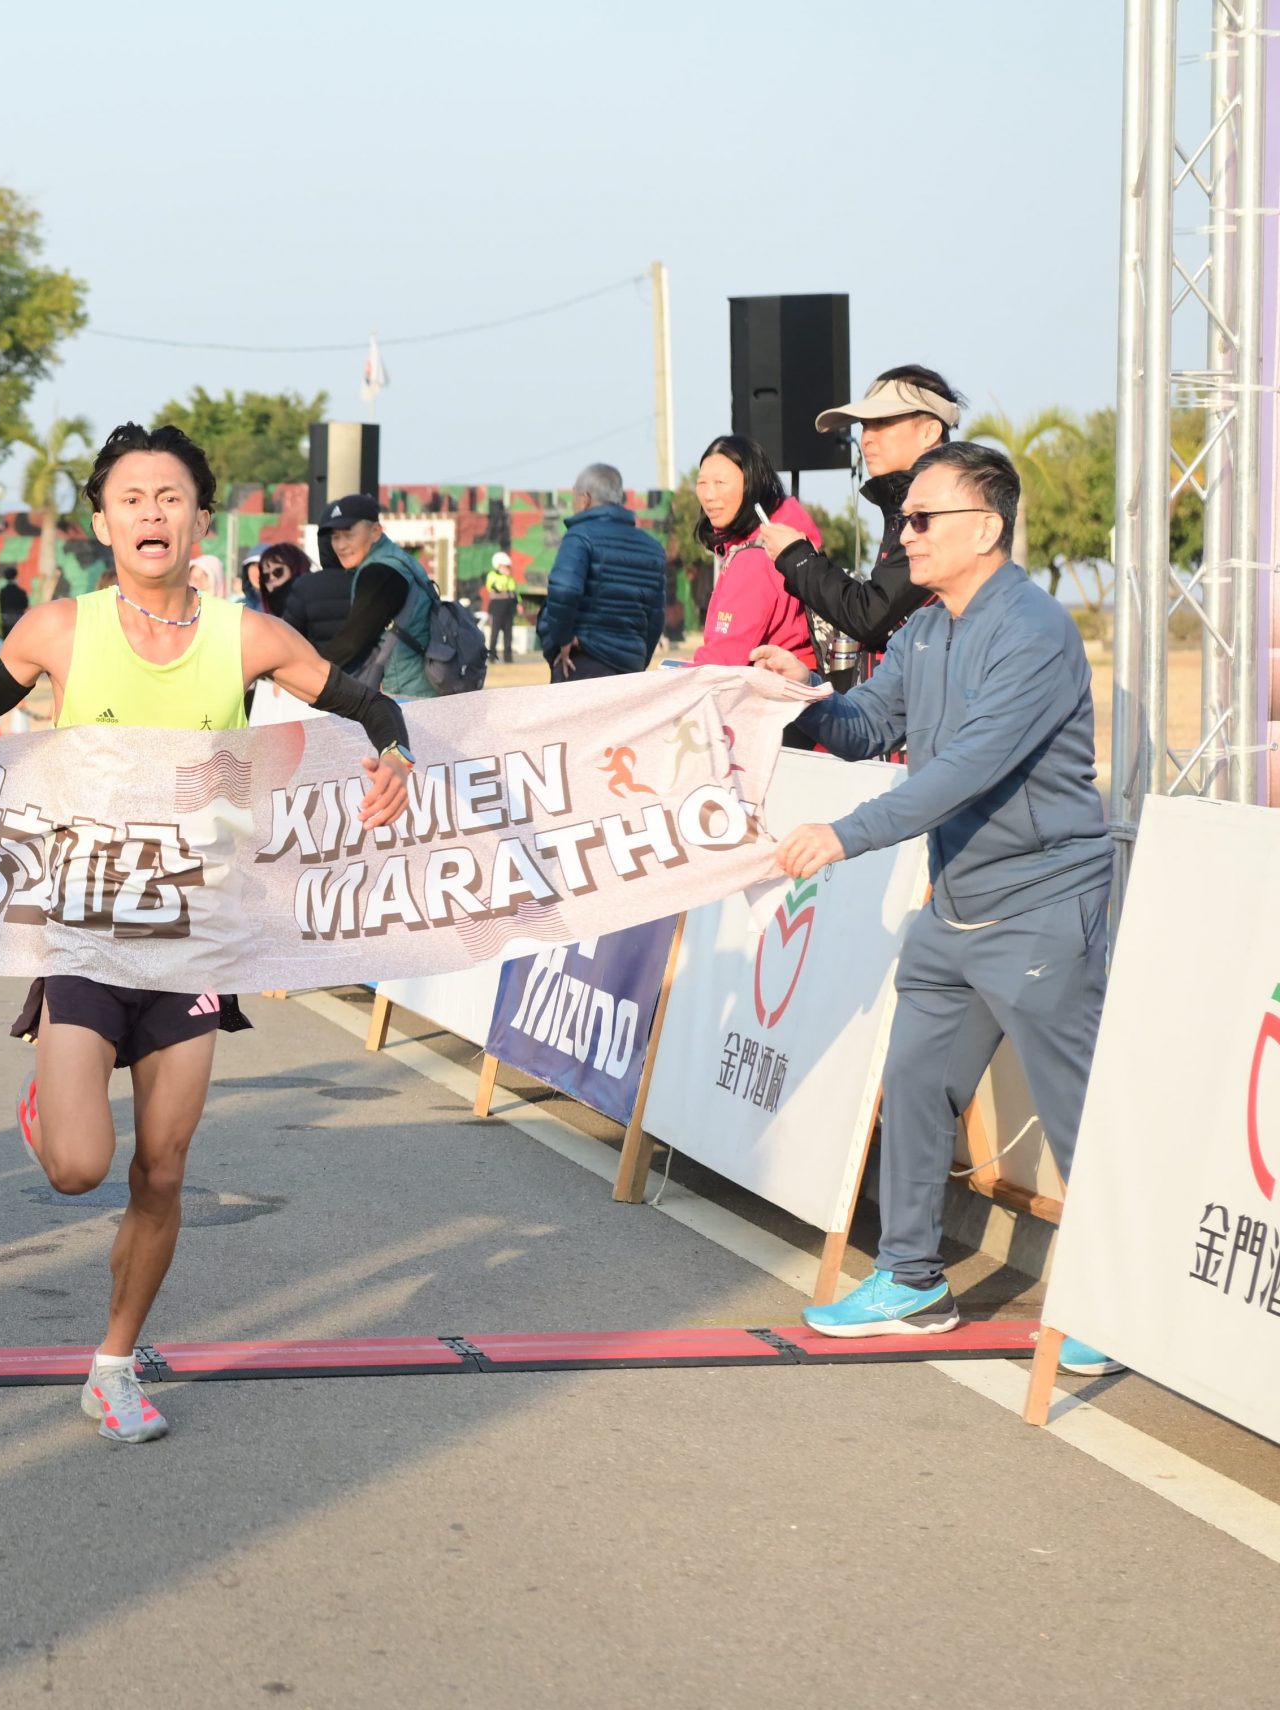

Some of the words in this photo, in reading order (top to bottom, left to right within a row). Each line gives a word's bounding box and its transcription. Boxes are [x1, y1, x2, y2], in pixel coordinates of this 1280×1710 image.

[293, 784, 760, 940] MARATHO
[716, 1031, 789, 1114] 金門酒廠
